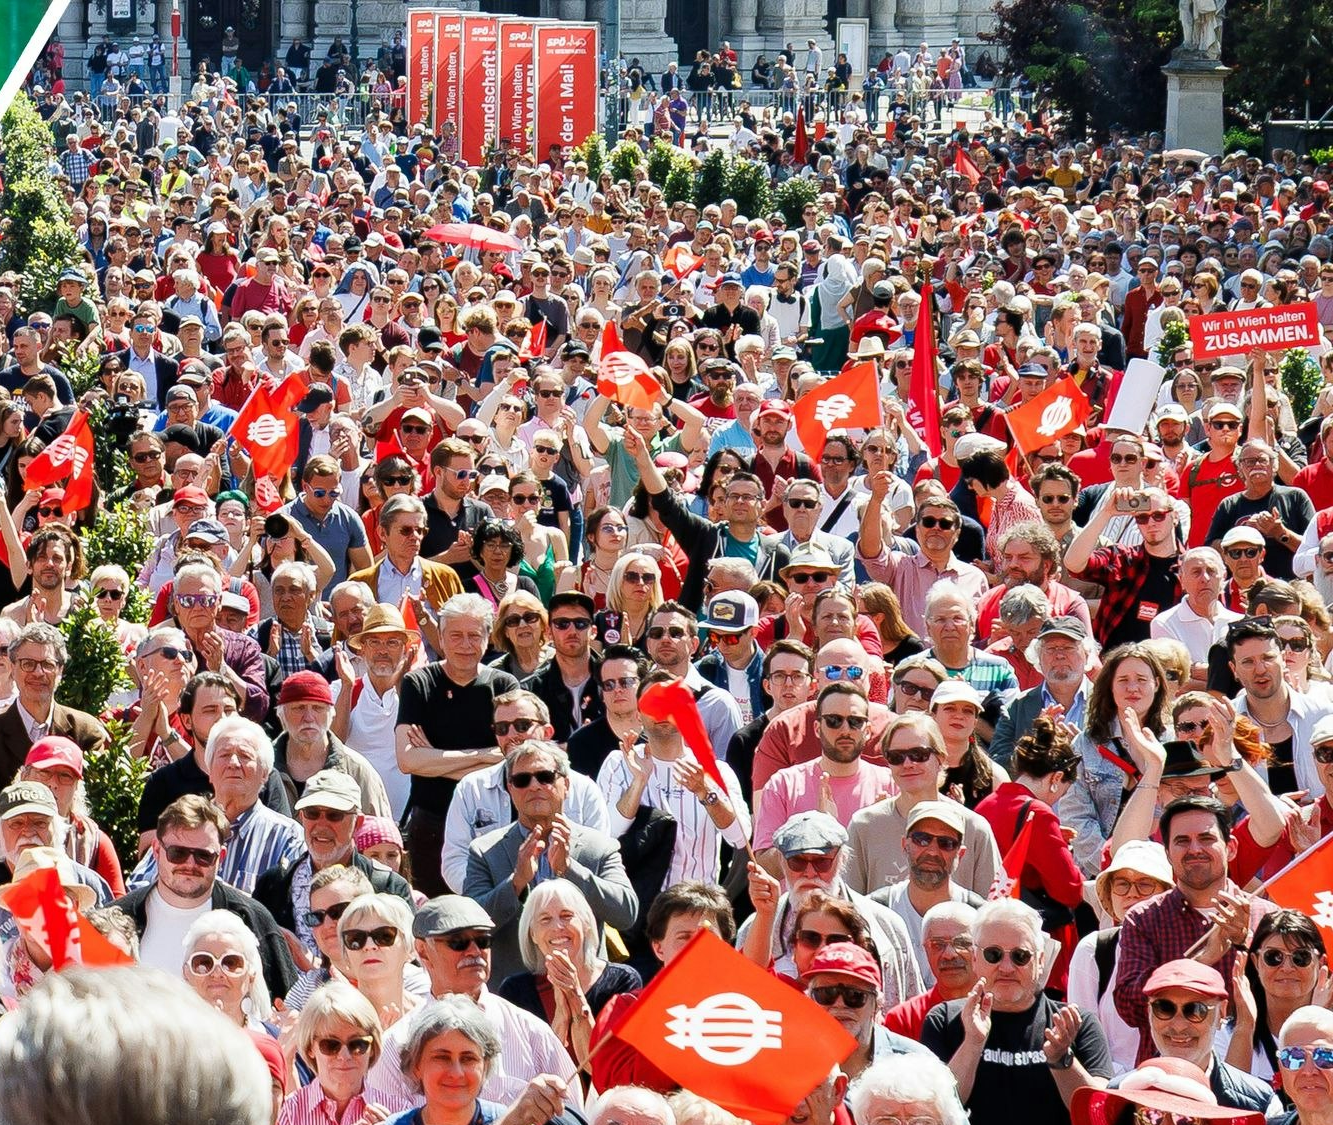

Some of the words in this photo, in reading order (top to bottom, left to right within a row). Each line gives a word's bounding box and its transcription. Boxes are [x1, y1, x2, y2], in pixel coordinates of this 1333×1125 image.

[546, 36, 566, 47] SPÖ
[420, 46, 430, 75] halten
[447, 51, 457, 83] halten
[512, 64, 524, 99] halten
[560, 64, 574, 98] Mai!
[447, 85, 456, 110] Wien
[481, 49, 496, 148] reundschaft!
[512, 101, 523, 130] Wien
[560, 115, 574, 141] der
[1201, 320, 1221, 333] Wir
[1224, 319, 1235, 330] in
[1237, 315, 1267, 328] Wien
[1269, 311, 1306, 325] halten
[1204, 324, 1314, 352] ZUSAMMEN.
